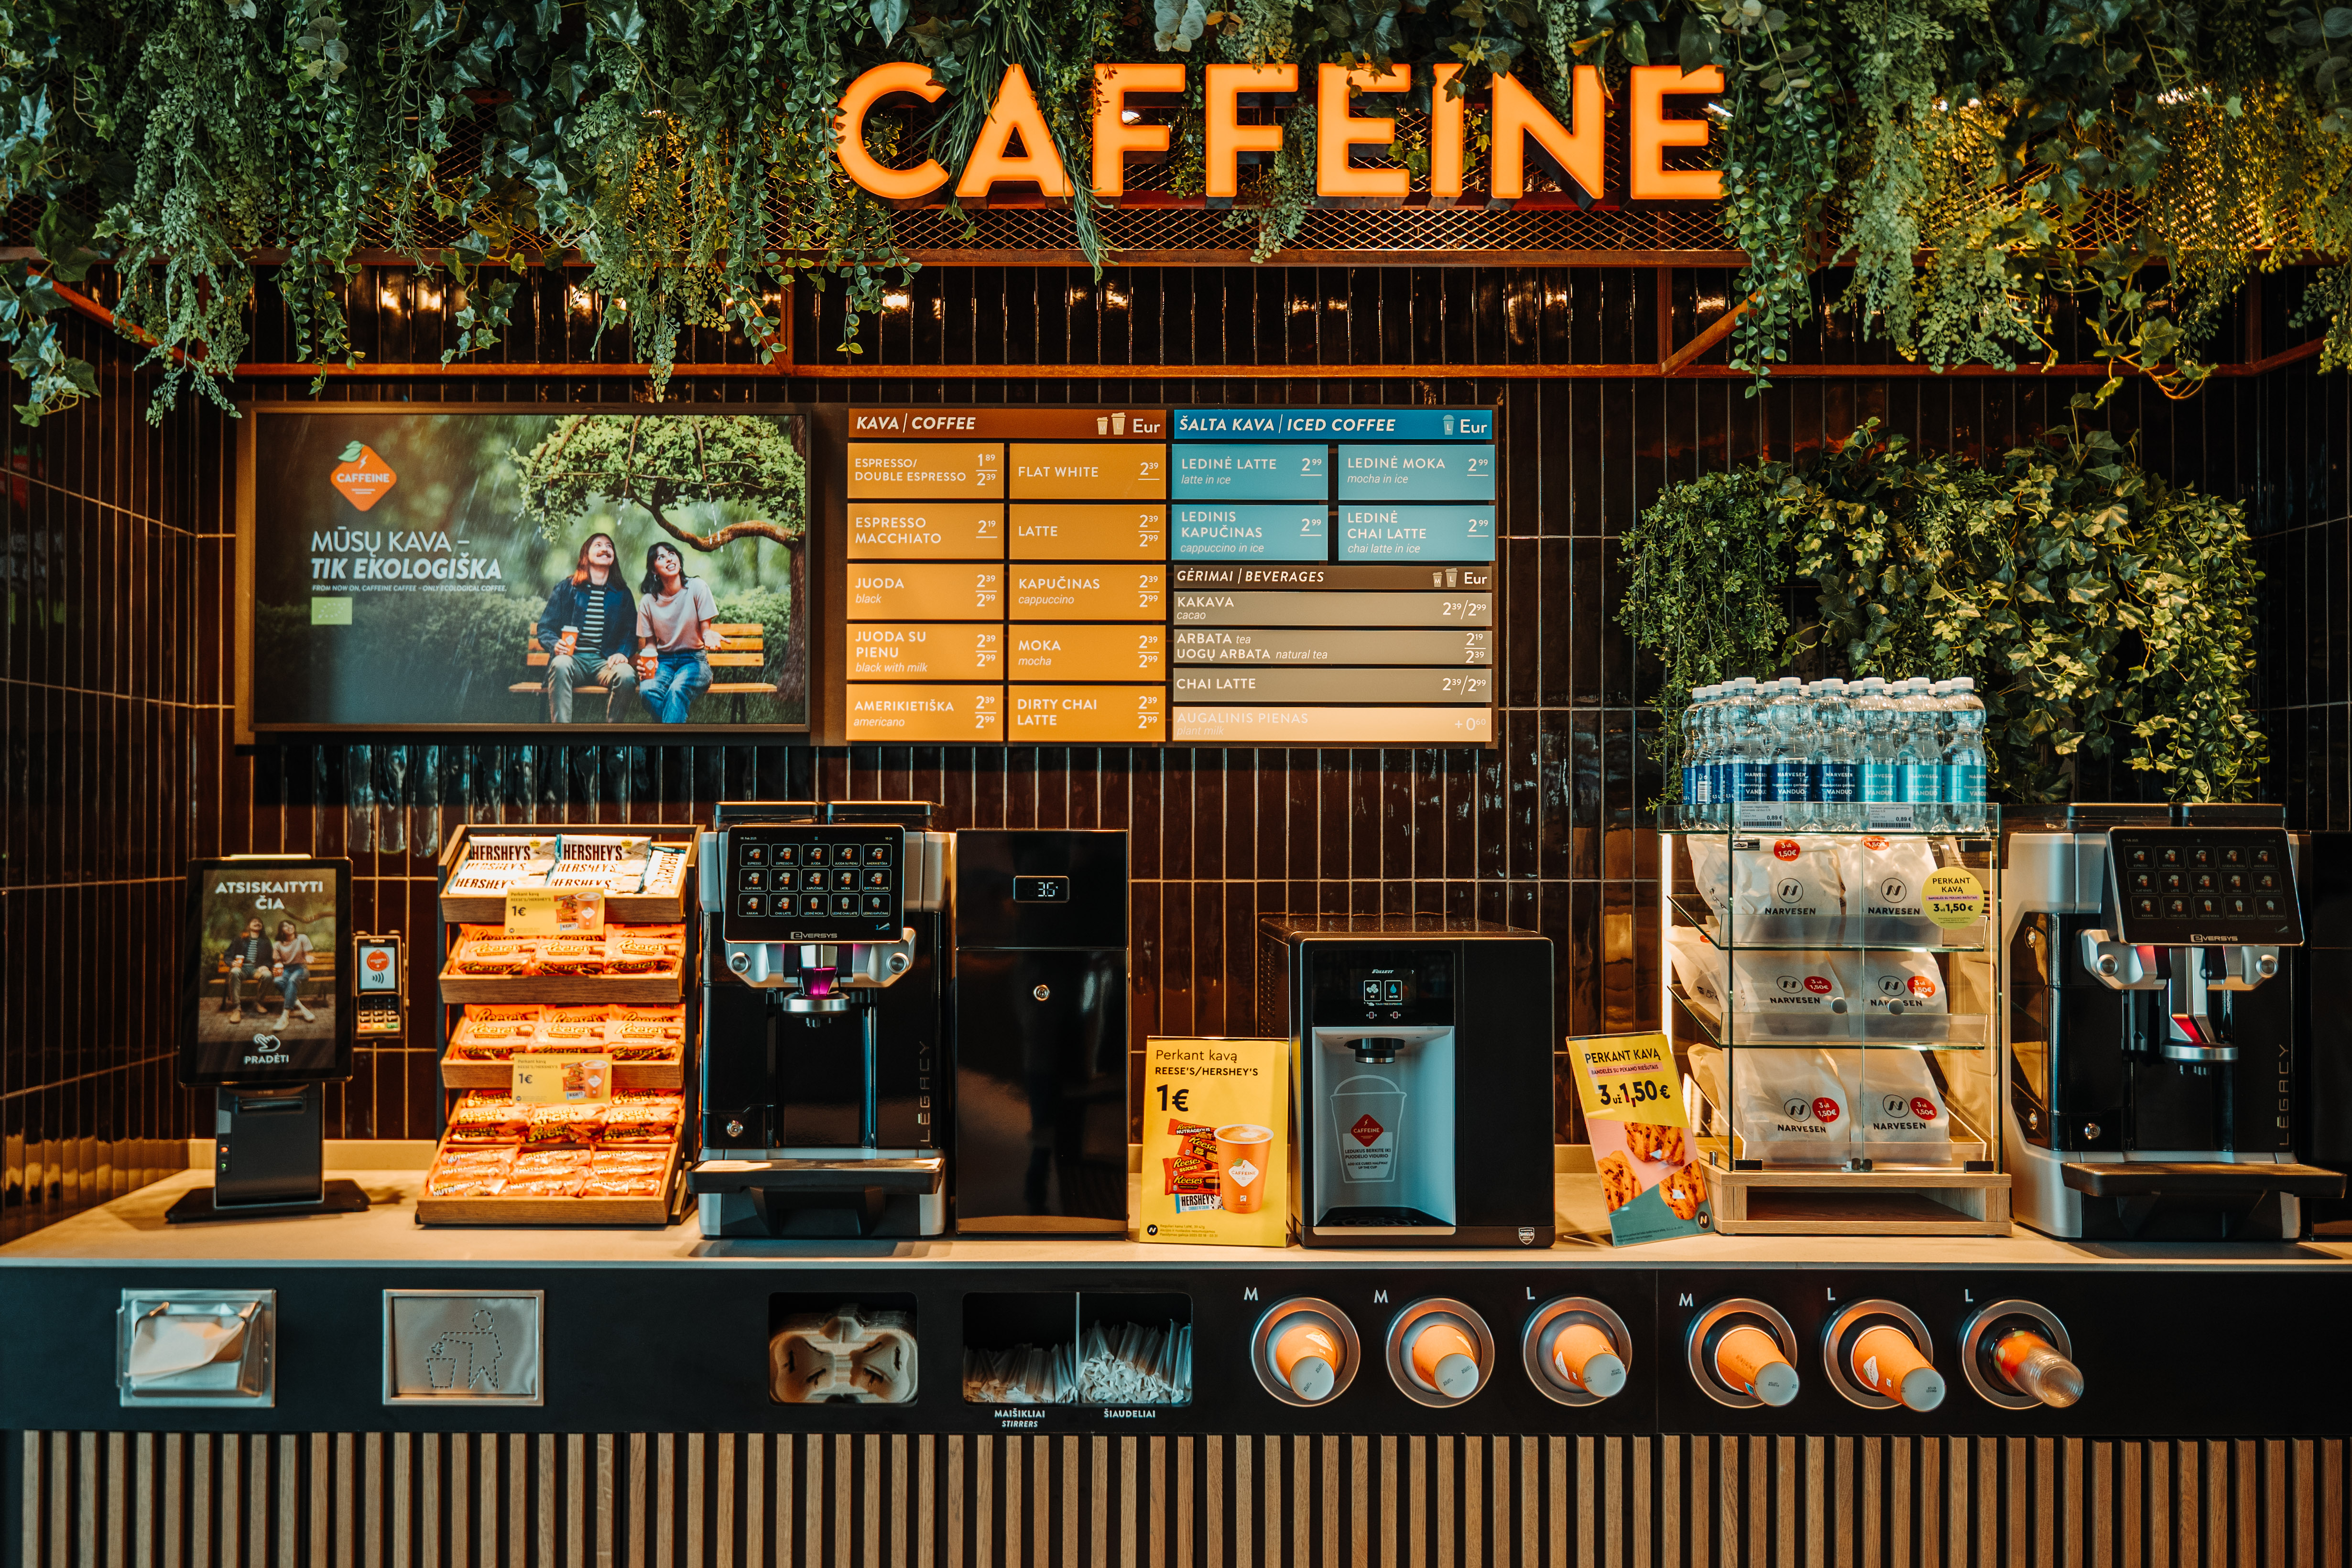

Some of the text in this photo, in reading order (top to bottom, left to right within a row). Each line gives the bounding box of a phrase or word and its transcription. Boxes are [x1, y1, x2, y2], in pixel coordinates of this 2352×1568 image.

[837, 61, 1725, 200] CAFFEINE
[857, 417, 1160, 433] KAVA COFFEE Eur
[1179, 415, 1487, 434] ŠALTA KAVA ICED COFFEE Eur
[855, 458, 917, 468] ESPRESSO/
[1182, 456, 1277, 469] LEDINĖ LATTE
[1348, 456, 1445, 468] LEDINĖ MOKA
[337, 473, 390, 482] CAFFEINE
[855, 472, 966, 481] DOUBLE ESPRESSO
[1018, 467, 1099, 477] FLAT WHITE
[1181, 474, 1230, 484] latte in ice
[1347, 474, 1408, 484] mocha in ice
[1182, 512, 1236, 522] LEDINIS
[1348, 510, 1398, 523] LEDINĖ
[856, 517, 926, 528] ESPRESSO
[1018, 526, 1058, 536] LATTE
[1181, 525, 1262, 538] KAPUČINAS
[1348, 529, 1426, 539] CHAI LATTE
[311, 526, 452, 557] MŪSŲ KAVA
[855, 534, 941, 543] MACCHIATO
[1180, 543, 1264, 555] cappuccino in ice
[1348, 544, 1420, 554] chai latte in ice
[311, 552, 502, 579] TIK EKOLOGIŠKA
[1177, 568, 1487, 585] GĖRIMAI BEVERAGES Eur
[855, 578, 904, 588] JUODA
[1019, 577, 1100, 589] KAPUČINAS
[856, 594, 882, 604] black
[1018, 595, 1074, 606] cappuccino
[1177, 597, 1234, 607] KAKAVA
[1176, 611, 1206, 620] cacao
[855, 632, 926, 642] JUODA SU
[1177, 633, 1251, 644] ARBATA tea
[1018, 640, 1061, 650] MOKA
[856, 647, 899, 658] PIENU
[1176, 648, 1328, 661] UOGŲ ARBATA natural tea
[1018, 656, 1051, 665] mocha
[856, 663, 927, 672] black with milk
[1176, 678, 1256, 689] CHAI LATTE
[855, 699, 954, 711] AMERIKIETIŠKA
[1017, 699, 1097, 710] DIRTY CHAI
[854, 717, 905, 727] americano
[1017, 715, 1057, 725] LATTE
[1177, 713, 1308, 724] AUGALINIS PIENAS
[215, 881, 323, 894] ATSISKAITYTI
[255, 895, 285, 910] ČIA
[512, 906, 526, 916] 1€
[1765, 907, 1816, 915] NARVESEN
[1868, 907, 1920, 915] NARVESEN
[1156, 1050, 1237, 1063] Perkant kavą
[1585, 1048, 1661, 1064] PERKANT KAVĄ
[1156, 1084, 1189, 1112] 1€
[1598, 1080, 1670, 1107] 3 už 1,50 €
[1243, 1286, 1259, 1301] M
[1374, 1289, 1389, 1304] M
[1526, 1286, 1535, 1299] L
[1827, 1287, 1835, 1300] L
[1965, 1289, 1973, 1302] L
[1678, 1292, 1693, 1307] M
[994, 1408, 1045, 1418] MAIŠIKLIAI
[1104, 1408, 1155, 1418] ŠIAUDELIAI
